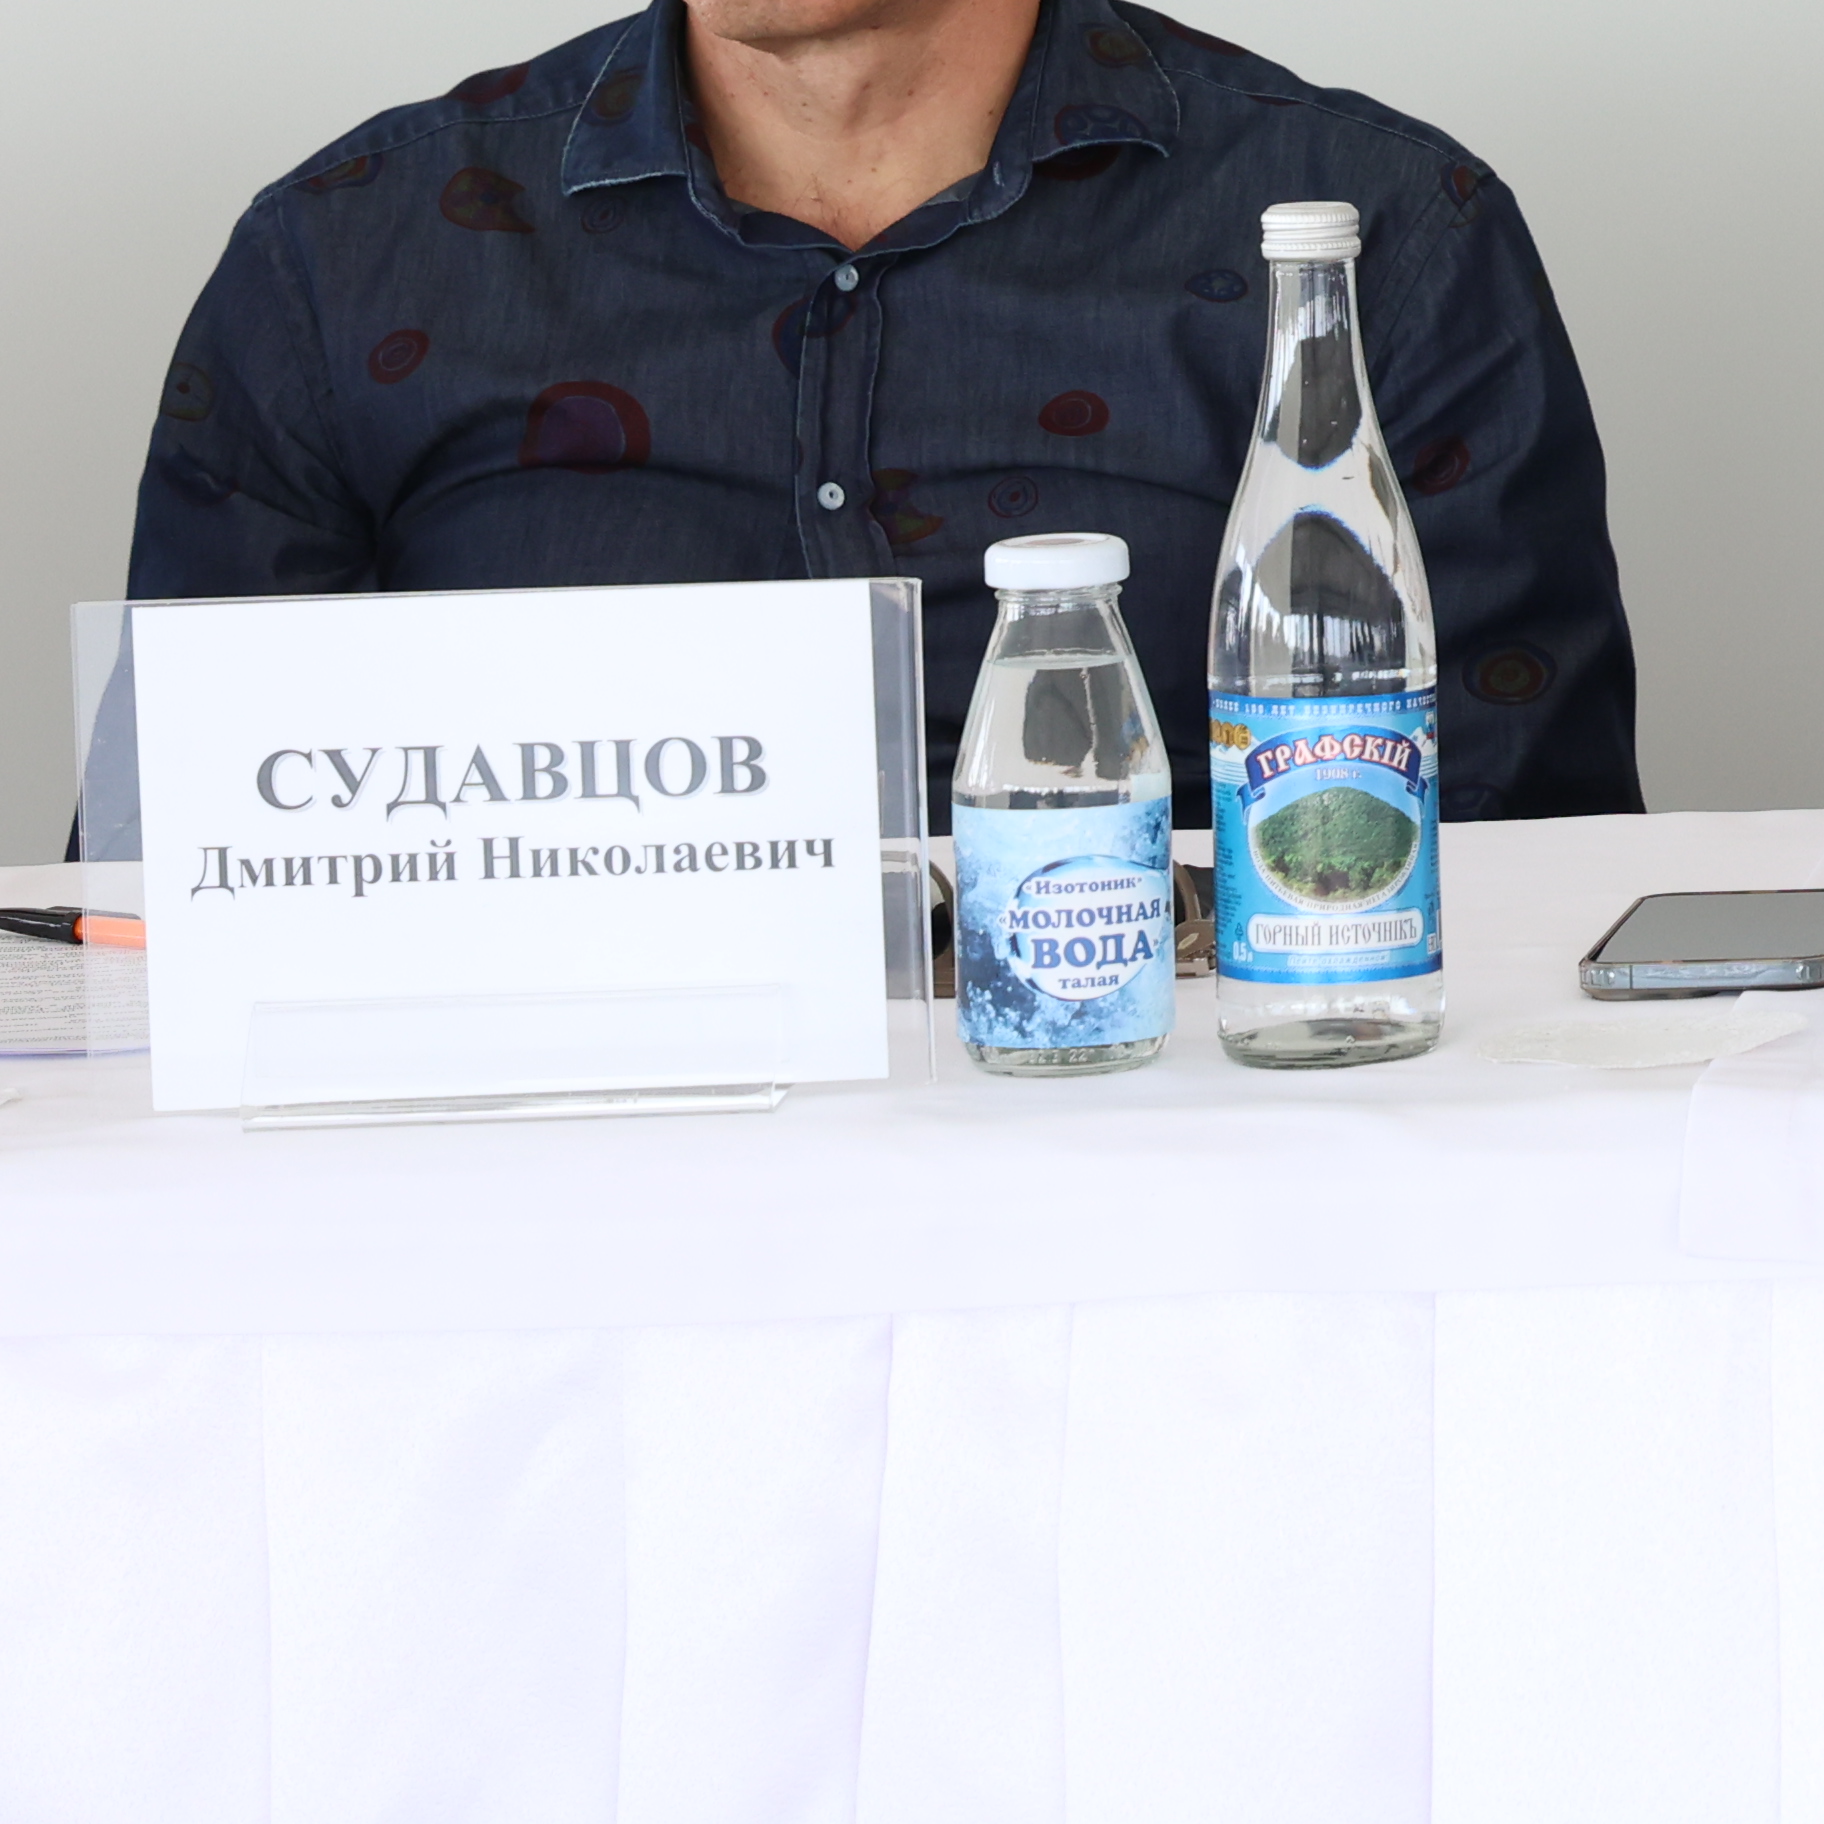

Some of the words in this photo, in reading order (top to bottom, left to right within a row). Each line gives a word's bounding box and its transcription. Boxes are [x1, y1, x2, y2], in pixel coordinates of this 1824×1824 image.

[256, 735, 769, 819] СУДАВЦОВ
[1315, 768, 1349, 780] 1908
[191, 839, 458, 899] Дмитрий
[481, 835, 836, 882] Николаевич
[1025, 877, 1142, 895] «Изотоник»
[999, 898, 1161, 929] «МОЛОЧНАЯ
[1255, 920, 1322, 947] ГОРНЫЙ
[1031, 930, 1158, 970] ВОДА»
[1058, 974, 1120, 989] талая
